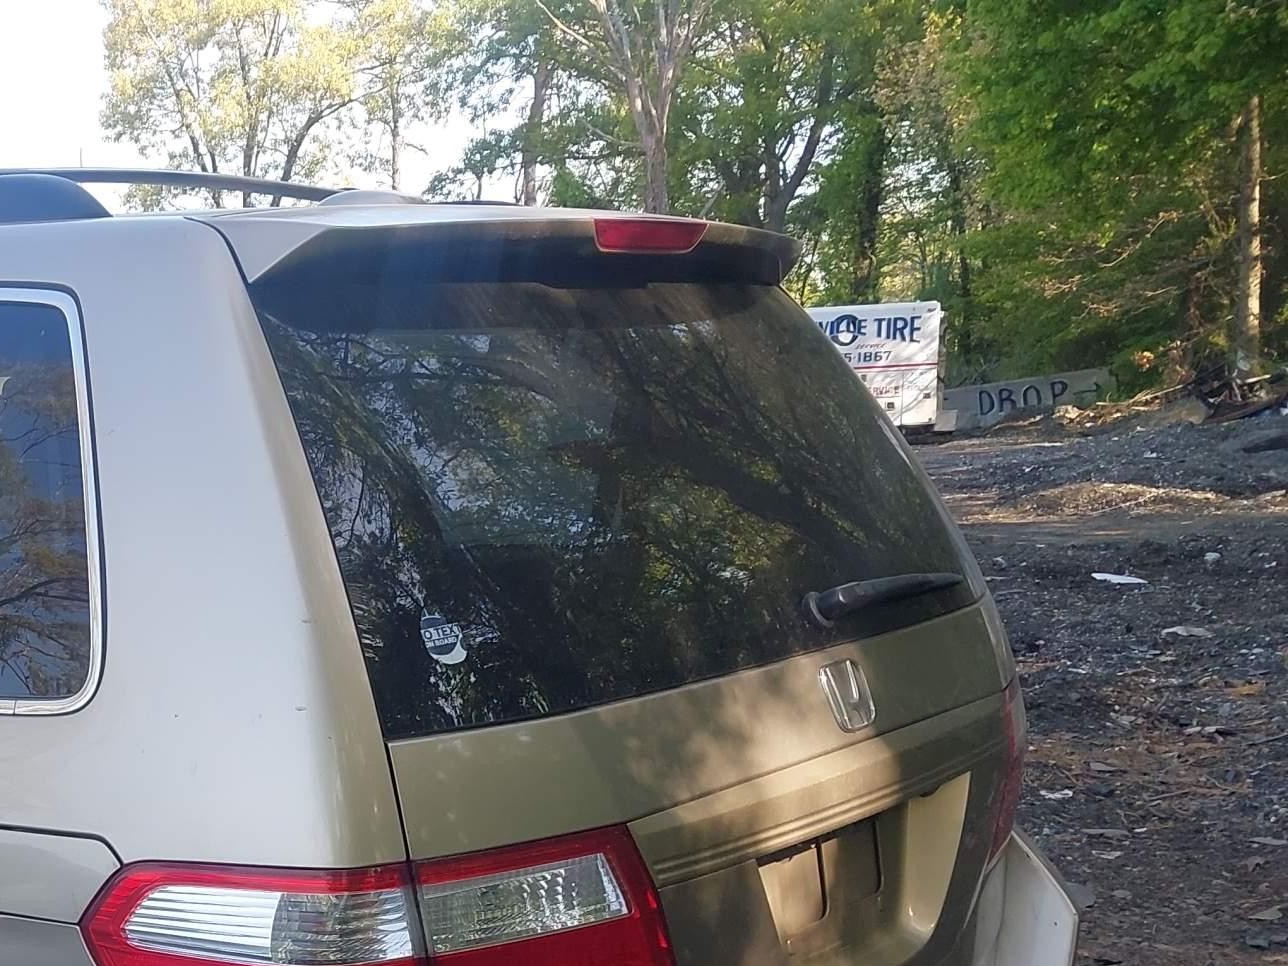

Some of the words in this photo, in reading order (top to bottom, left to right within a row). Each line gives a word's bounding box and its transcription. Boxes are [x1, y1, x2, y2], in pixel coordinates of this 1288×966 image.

[815, 318, 868, 337] VILLE
[873, 315, 922, 343] TIRE
[842, 350, 893, 362] 5-1867
[978, 379, 1069, 416] DROP
